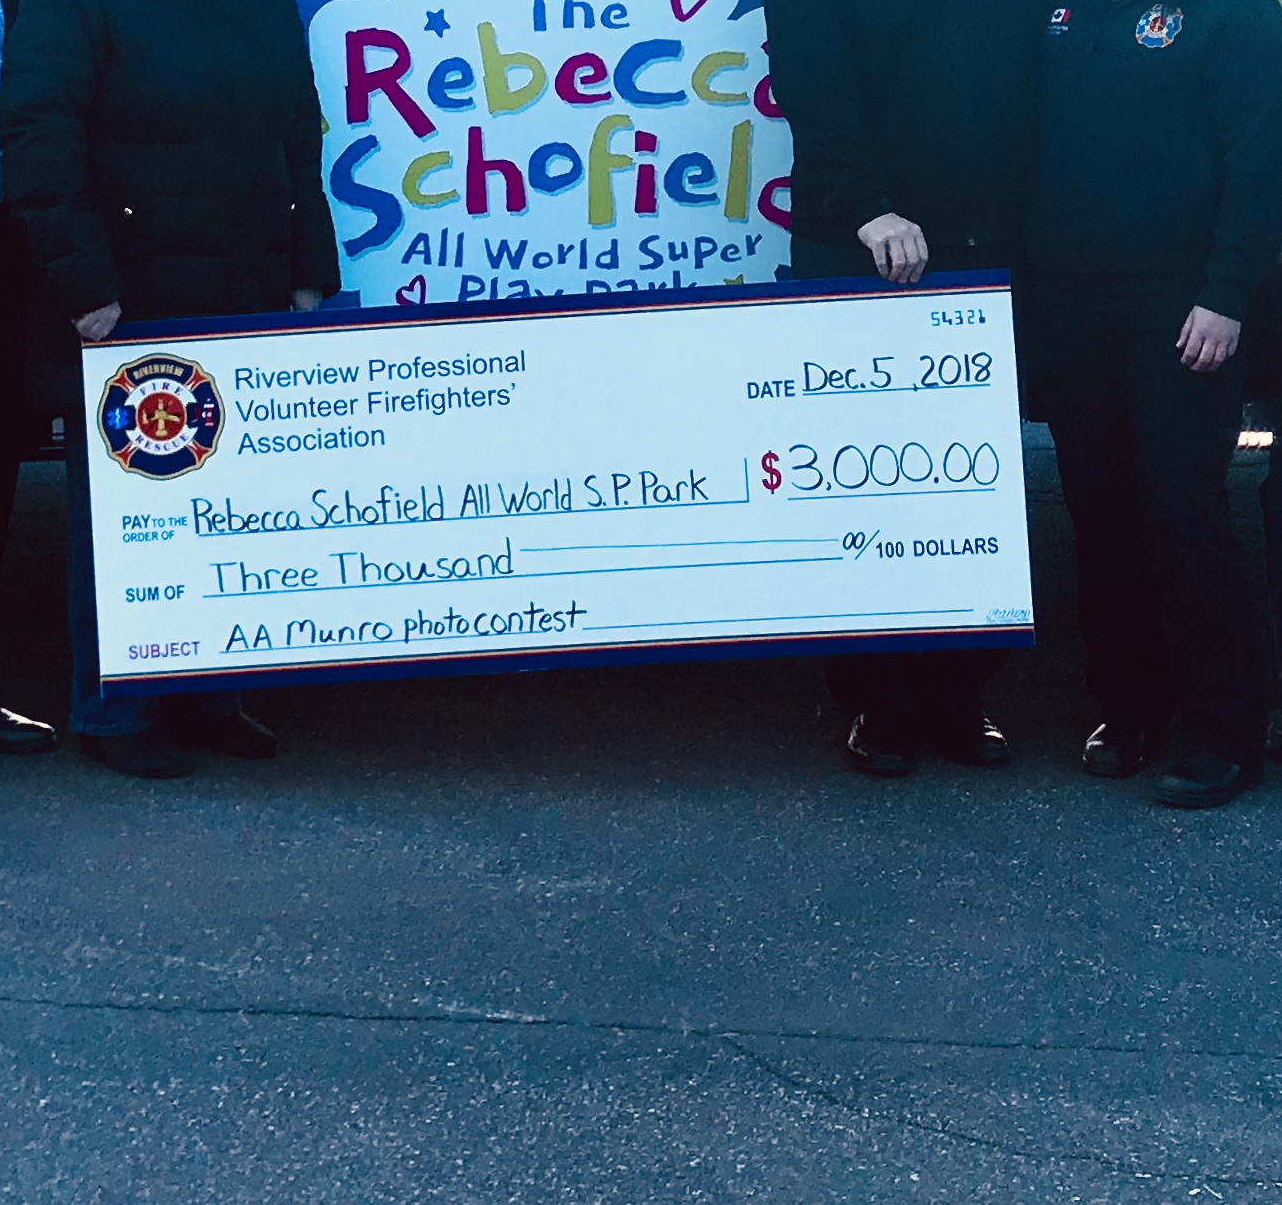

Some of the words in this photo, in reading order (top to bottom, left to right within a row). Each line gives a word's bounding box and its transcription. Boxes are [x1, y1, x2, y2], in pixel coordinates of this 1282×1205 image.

[400, 227, 464, 267] All
[484, 236, 620, 271] World
[639, 232, 763, 273] Super
[930, 309, 987, 327] 54321
[234, 367, 360, 389] Riverview
[368, 350, 527, 383] Professional
[139, 381, 183, 396] FIRE
[747, 380, 796, 399] DATE
[235, 396, 360, 422] Volunteer
[135, 433, 189, 453] RESCUE
[237, 428, 386, 455] Association
[191, 497, 302, 535] Rebecca
[311, 485, 444, 525] Schofield
[460, 483, 491, 518] All
[499, 477, 572, 514] World
[122, 515, 150, 530] PAY
[152, 517, 165, 528] TO
[168, 516, 188, 527] THE
[122, 531, 157, 543] ORDER
[160, 530, 175, 541] OF
[913, 537, 999, 556] DOLLARS
[209, 561, 319, 594] Three
[329, 537, 514, 585] Thousand
[125, 587, 159, 603] SUM
[163, 585, 185, 601] OF
[286, 618, 394, 645] Munro
[128, 642, 201, 660] SUBJECT
